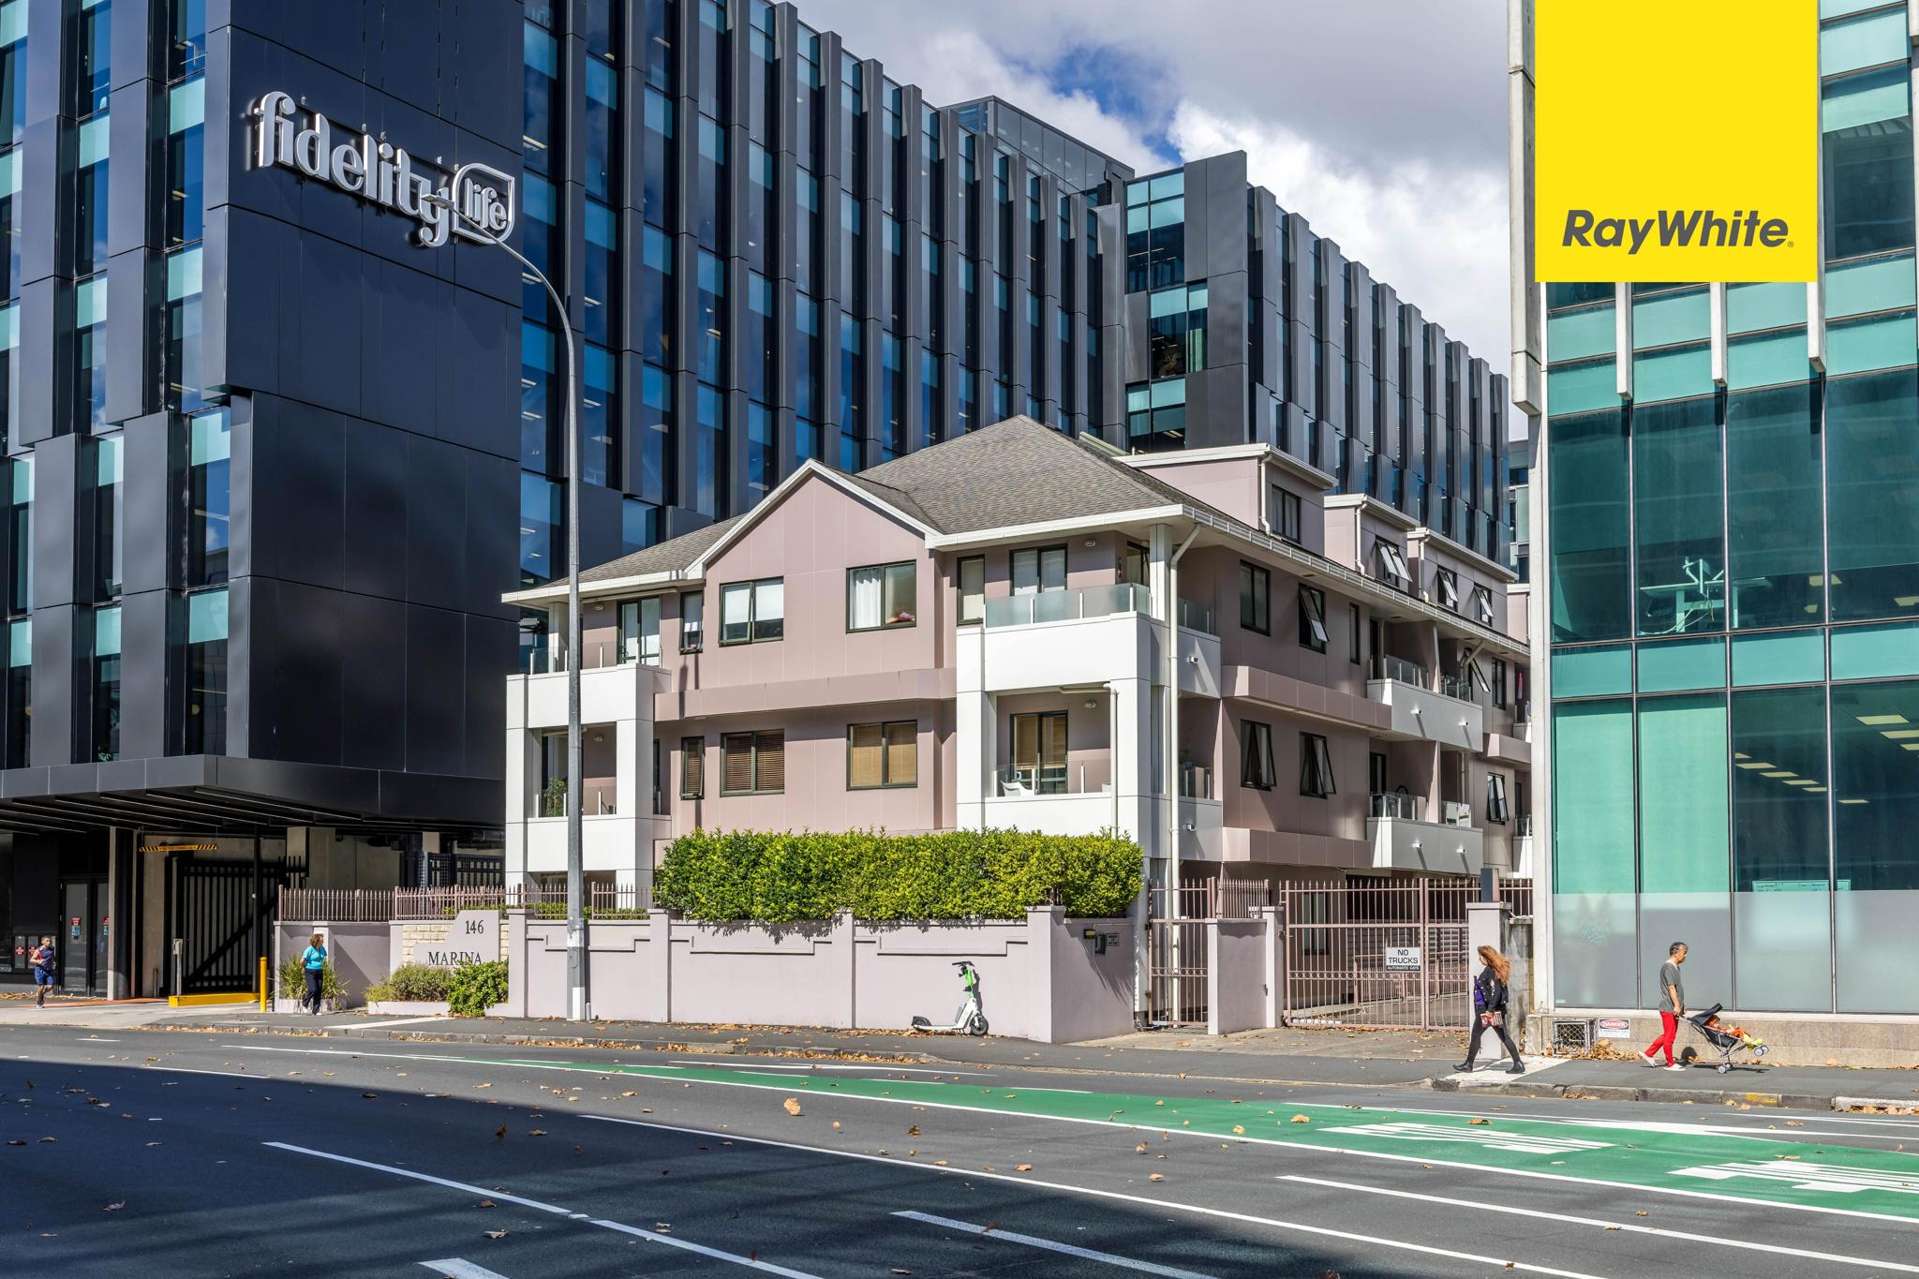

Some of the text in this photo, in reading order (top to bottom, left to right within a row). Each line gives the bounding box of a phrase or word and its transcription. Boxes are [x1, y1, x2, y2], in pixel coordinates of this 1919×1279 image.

[254, 91, 508, 247] fidelity life
[465, 919, 484, 934] 146
[428, 951, 482, 966] MARINA
